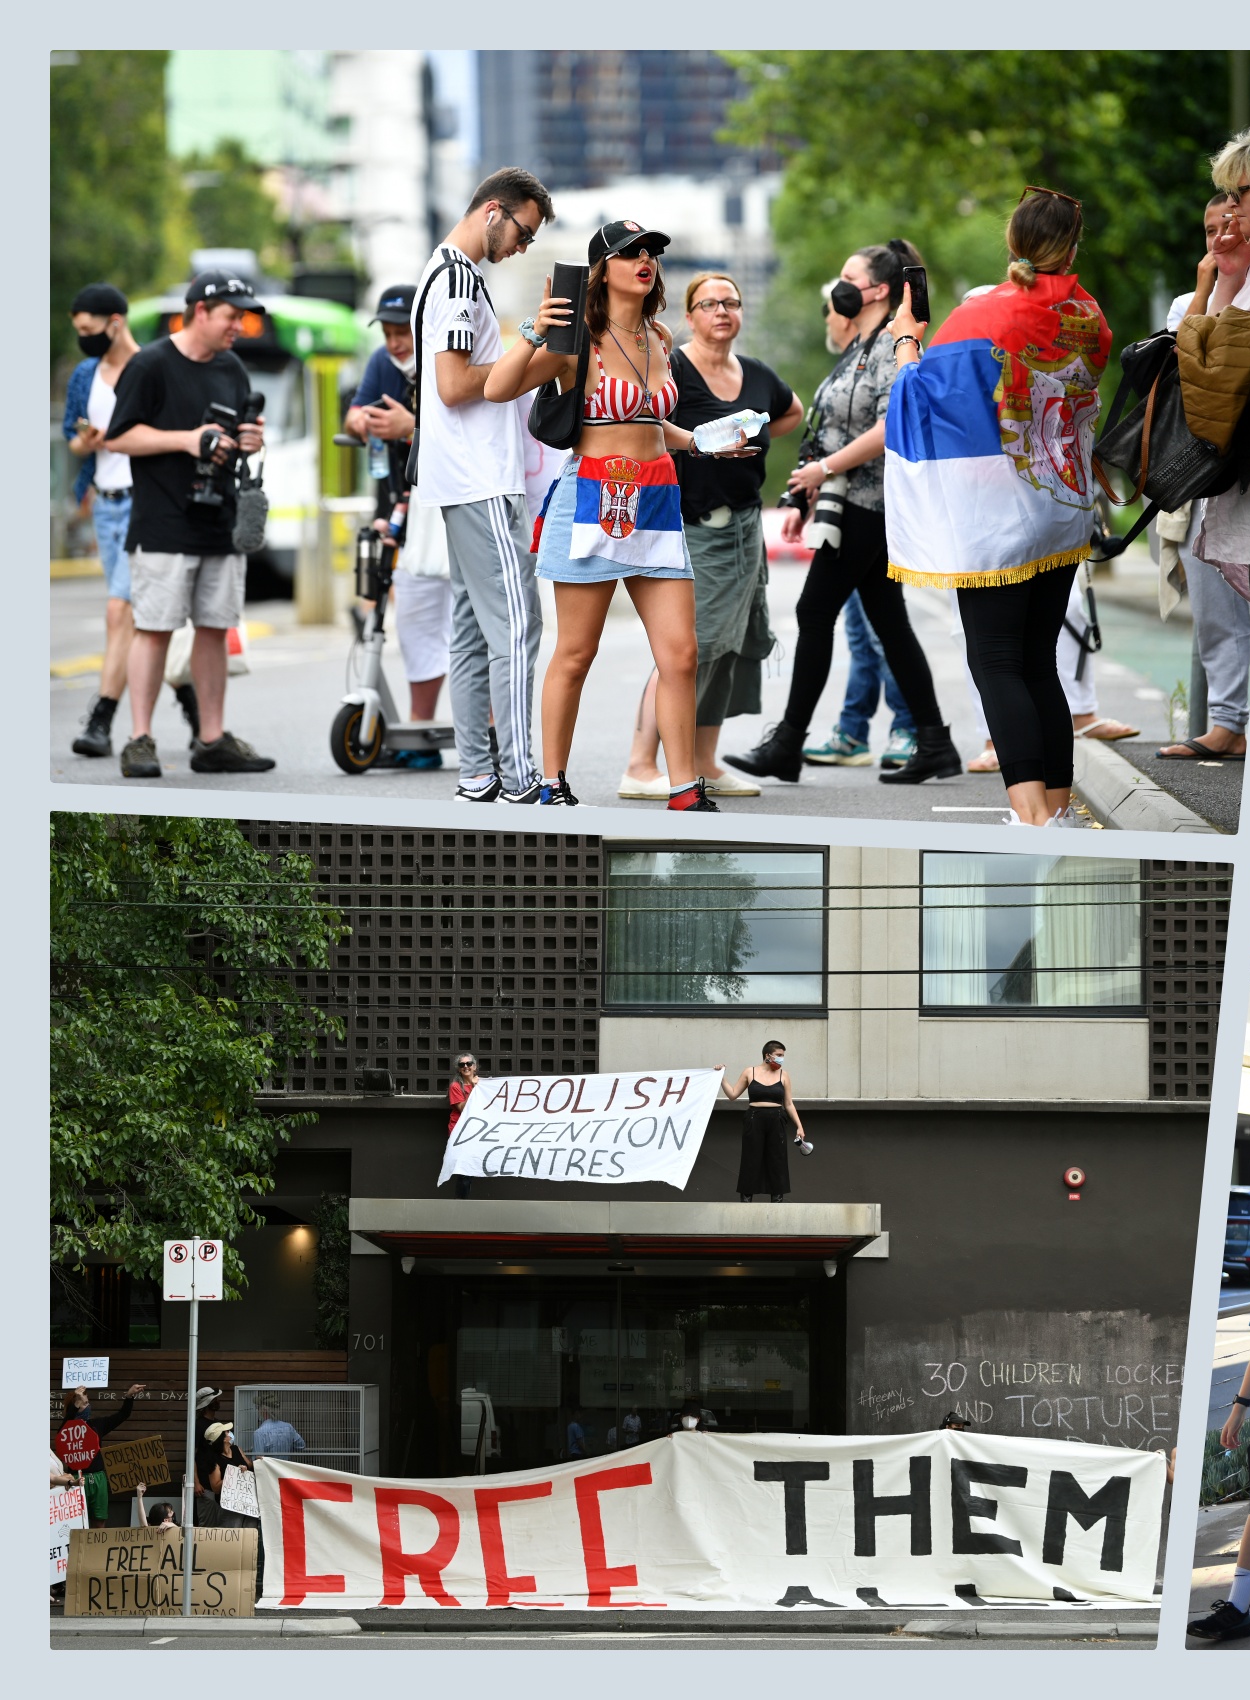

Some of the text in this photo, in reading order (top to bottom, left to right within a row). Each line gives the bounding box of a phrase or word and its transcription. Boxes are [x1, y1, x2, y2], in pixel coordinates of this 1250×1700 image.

[483, 1076, 690, 1114] ABOLISH
[453, 1116, 691, 1150] DETENTION
[482, 1145, 625, 1178] CENTRES
[174, 1246, 184, 1261] S
[203, 1245, 214, 1259] P
[353, 1333, 384, 1350] 701
[67, 1359, 106, 1369] FREE THE
[65, 1371, 107, 1383] REFUGEES
[921, 1360, 1185, 1397] 30 CHILDREN LOCKE
[98, 1392, 117, 1400] FOR
[871, 1396, 915, 1422] friends
[954, 1401, 993, 1424] AND
[60, 1424, 87, 1442] STOP
[63, 1449, 96, 1464] TORTURE
[67, 1440, 83, 1451] THE
[104, 1439, 165, 1467] STOLEN LIVES
[109, 1463, 170, 1493] STOLEN LAND
[128, 1460, 142, 1473] ON
[753, 1455, 1131, 1573] THEM
[87, 1531, 108, 1544] END
[278, 1463, 667, 1607] FREE
[106, 1543, 206, 1572] FREE ALL
[88, 1571, 227, 1611] REFUGEES
